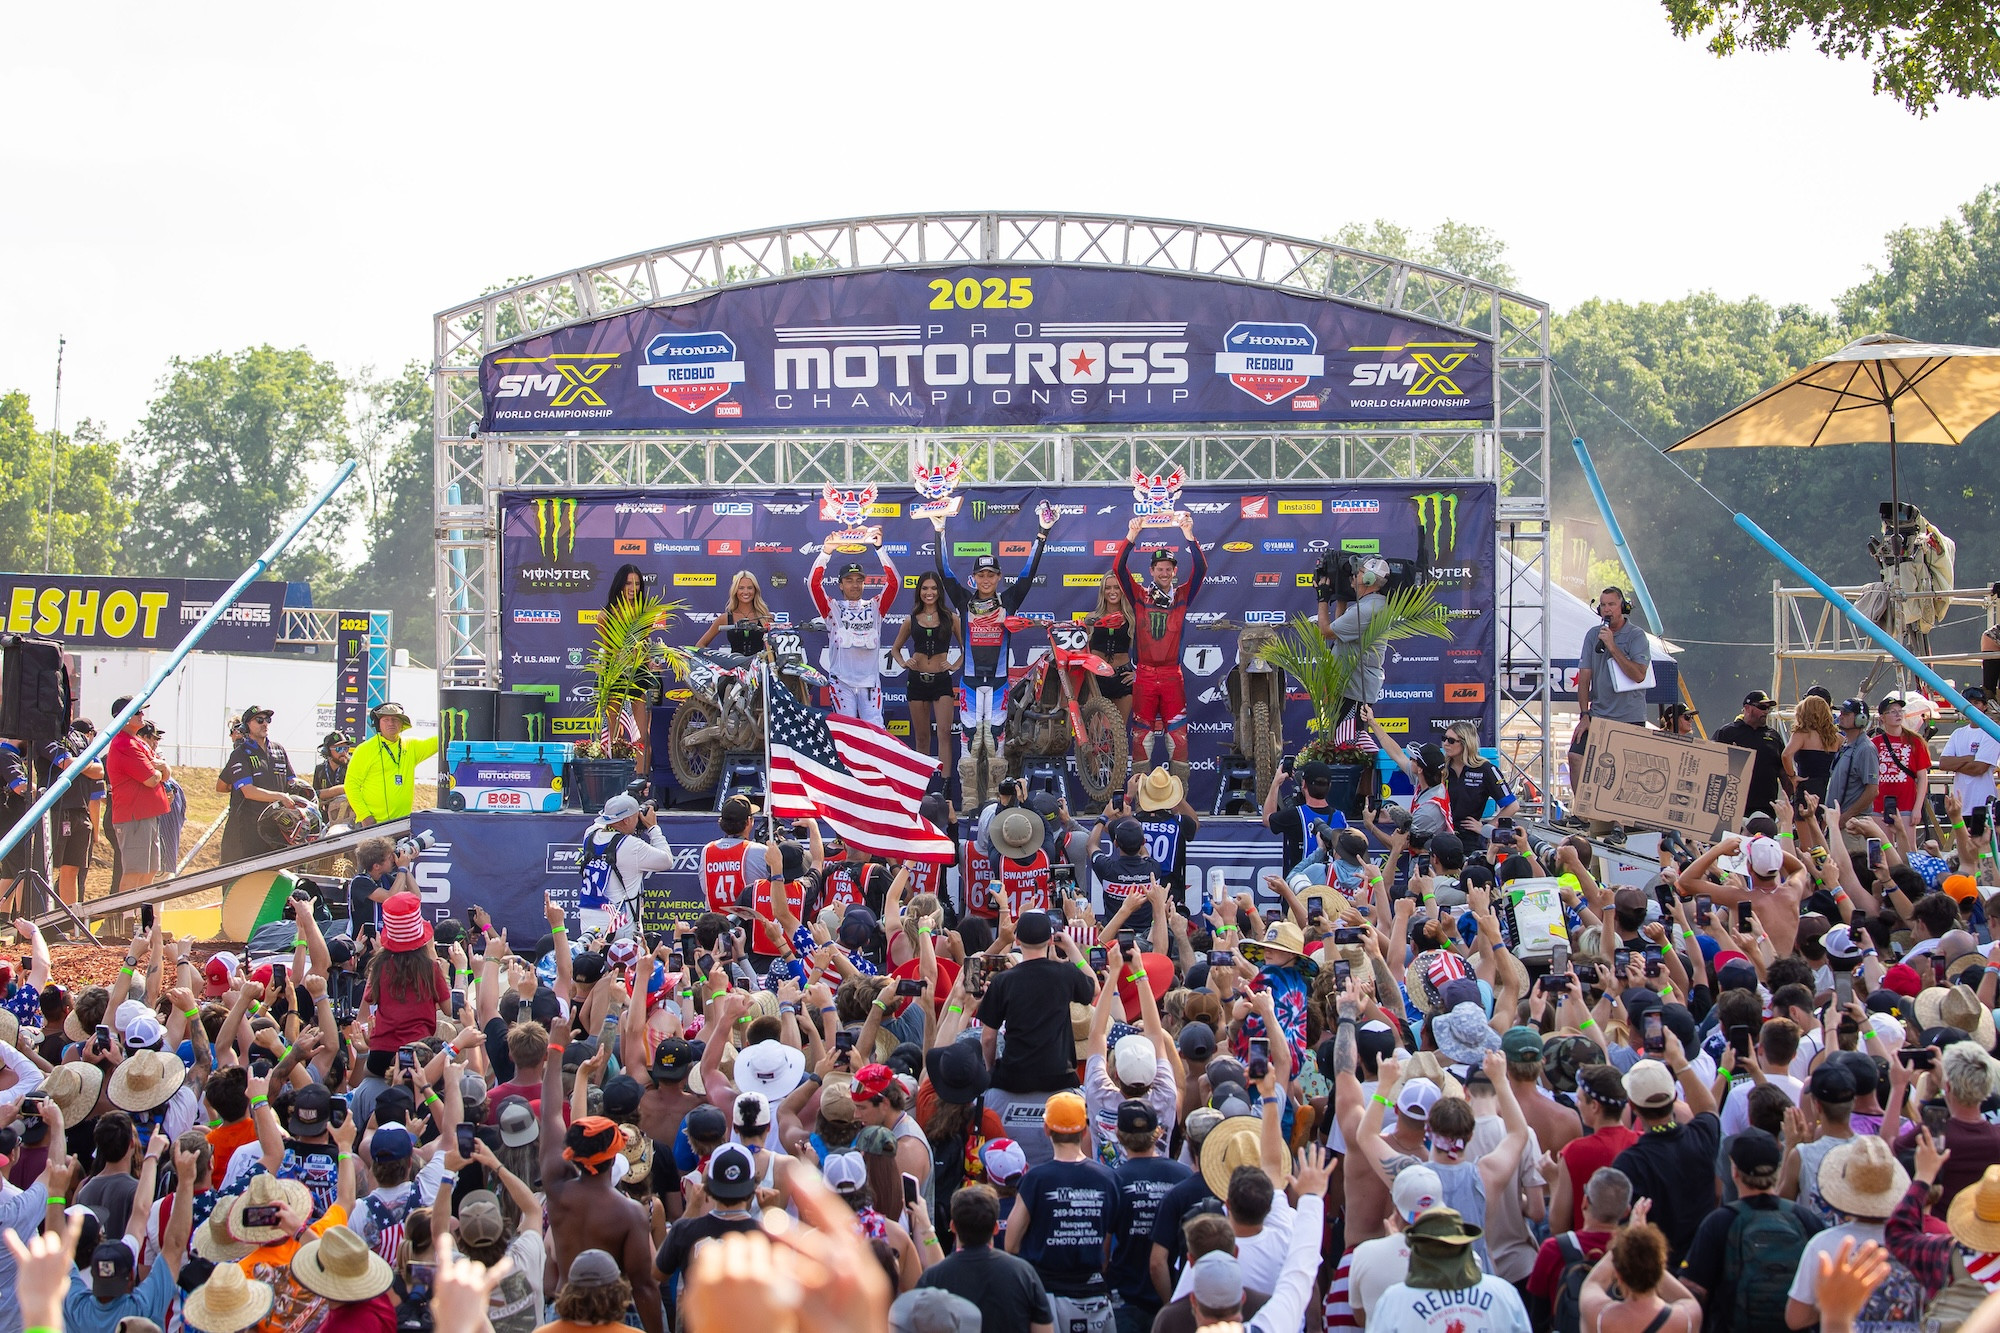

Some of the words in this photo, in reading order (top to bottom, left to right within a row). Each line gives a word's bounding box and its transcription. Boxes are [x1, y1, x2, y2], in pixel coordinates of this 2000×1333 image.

[928, 276, 1034, 311] 2025
[928, 321, 1034, 339] PRO
[1248, 335, 1310, 347] HONDA
[668, 343, 730, 357] HONDA
[774, 341, 1190, 390] MOTOCROSS
[1246, 356, 1294, 372] REDBUD
[667, 365, 716, 382] REDBUD
[1239, 375, 1300, 384] NATIONAL
[1348, 352, 1471, 396] SMX
[495, 363, 612, 407] SMX
[662, 384, 722, 395] NATIONAL
[775, 389, 1190, 410] CHAMPIONSHIP
[1292, 398, 1319, 411] DIXXON
[1350, 399, 1388, 409] WORLD
[1389, 397, 1471, 409] CHAMPIONSHIP
[495, 409, 532, 420] WORLD
[534, 408, 613, 420] CHAMPIONSHIP
[716, 405, 742, 417] DIXXON
[713, 502, 754, 516] WPS
[763, 503, 811, 513] FLY
[1184, 502, 1231, 512] FLY
[1283, 503, 1316, 511] Insta360
[1332, 499, 1379, 508] PARTS
[620, 543, 640, 551] KTM
[662, 543, 701, 553] Husqvarna
[1005, 545, 1026, 553] KTM
[1046, 544, 1086, 554] Husqvarna
[1269, 541, 1295, 549] YAMAHA
[521, 567, 592, 581] MONSTER
[1202, 575, 1238, 585] AMURA
[4, 587, 170, 640] ESHOT
[180, 606, 272, 622] MOCROSS
[513, 609, 561, 618] PARTS
[1184, 612, 1227, 621] FLY
[1245, 610, 1286, 624] WPS
[340, 618, 369, 631] 2025
[513, 616, 561, 624] UNLIMITED
[776, 634, 802, 654] 22
[1056, 630, 1089, 650] 30
[524, 655, 538, 663] U.S.
[538, 655, 561, 664] ARMY
[572, 655, 578, 663] 2
[1384, 688, 1434, 700] Husqvarna
[1452, 689, 1478, 698] KTM
[553, 721, 601, 731] SUZU
[477, 772, 532, 780] MOTOCROSS
[488, 792, 521, 805] BOB
[1709, 776, 1722, 811] TRIFOLD
[1720, 773, 1742, 822] ArtSkills
[706, 861, 741, 874] CONVRG
[715, 875, 736, 904] 47
[836, 880, 853, 893] USA
[1017, 878, 1036, 889] LIVE
[571, 889, 578, 897] 6
[657, 912, 676, 920] LAS
[1412, 1285, 1494, 1320] REDBUD
